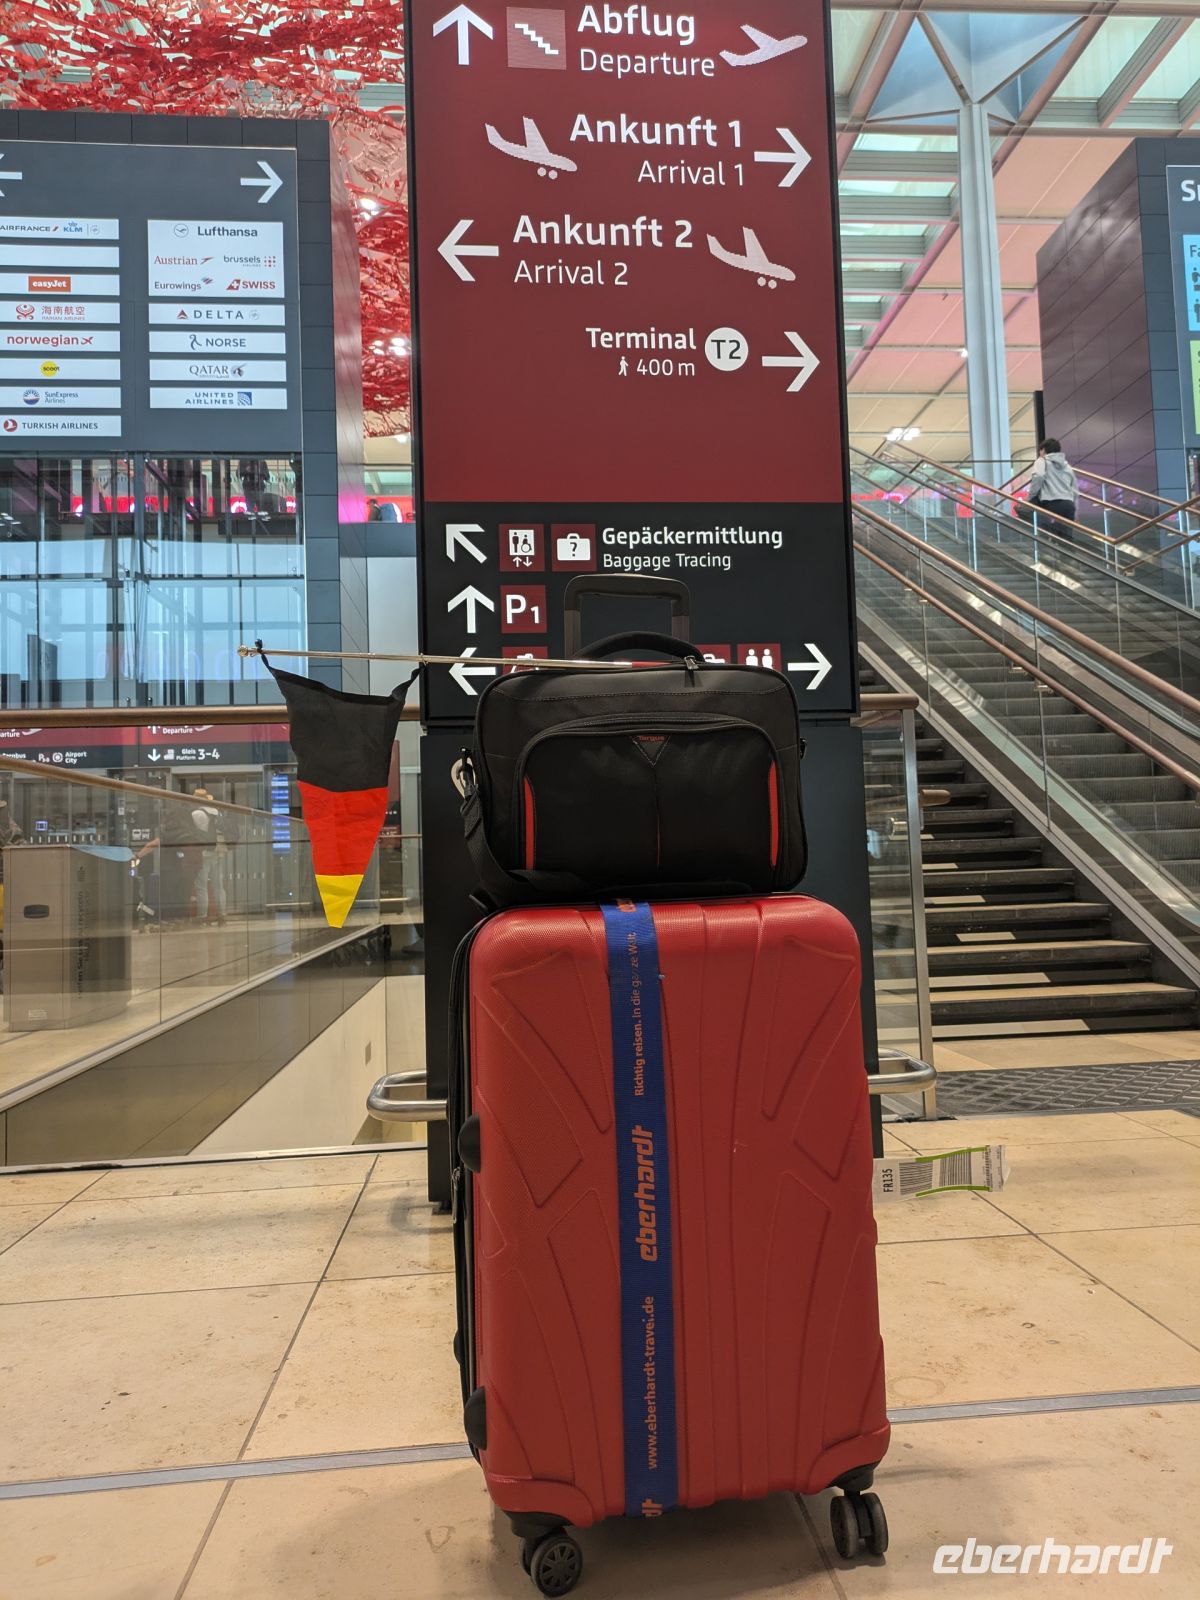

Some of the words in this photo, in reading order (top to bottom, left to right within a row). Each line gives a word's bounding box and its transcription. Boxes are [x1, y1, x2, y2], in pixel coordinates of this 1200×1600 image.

[577, 5, 696, 45] Abflug
[580, 49, 715, 78] Departure
[569, 114, 717, 147] Ankunft
[728, 120, 741, 148] 1
[637, 160, 726, 186] Arrival
[734, 163, 744, 187] 1
[197, 226, 258, 237] Lufthansa
[512, 214, 663, 248] Ankunft
[674, 219, 693, 249] 2
[154, 255, 198, 266] Austrian
[223, 255, 261, 264] brussels
[513, 259, 604, 285] Arrival
[614, 262, 629, 287] 2
[32, 280, 67, 289] easyJet
[154, 281, 202, 291] Eurowings
[242, 280, 276, 290] SWISS
[41, 305, 85, 315] 海南航空
[193, 309, 244, 320] DELTA
[6, 334, 79, 347] norwegian
[205, 338, 247, 348] NORSE
[585, 327, 697, 350] Terminal
[710, 338, 742, 360] T2
[189, 364, 229, 375] QATAR
[636, 359, 674, 377] 400
[44, 391, 79, 399] SunExpress
[22, 422, 59, 430] TURKISH
[60, 422, 98, 430] AIRLINES
[602, 526, 783, 549] Gepäckermittlung
[603, 553, 671, 571] Baggage
[675, 552, 732, 571] Tracing
[505, 593, 540, 624] P1
[162, 727, 193, 735] Departure
[65, 757, 78, 765] City
[630, 954, 642, 986] gaze
[630, 991, 641, 1007] die
[632, 1008, 641, 1018] In
[633, 1019, 642, 1057] reisen.
[634, 1058, 646, 1096] Richtig
[882, 1168, 894, 1193] FR135
[631, 1125, 658, 1262] eberhardt
